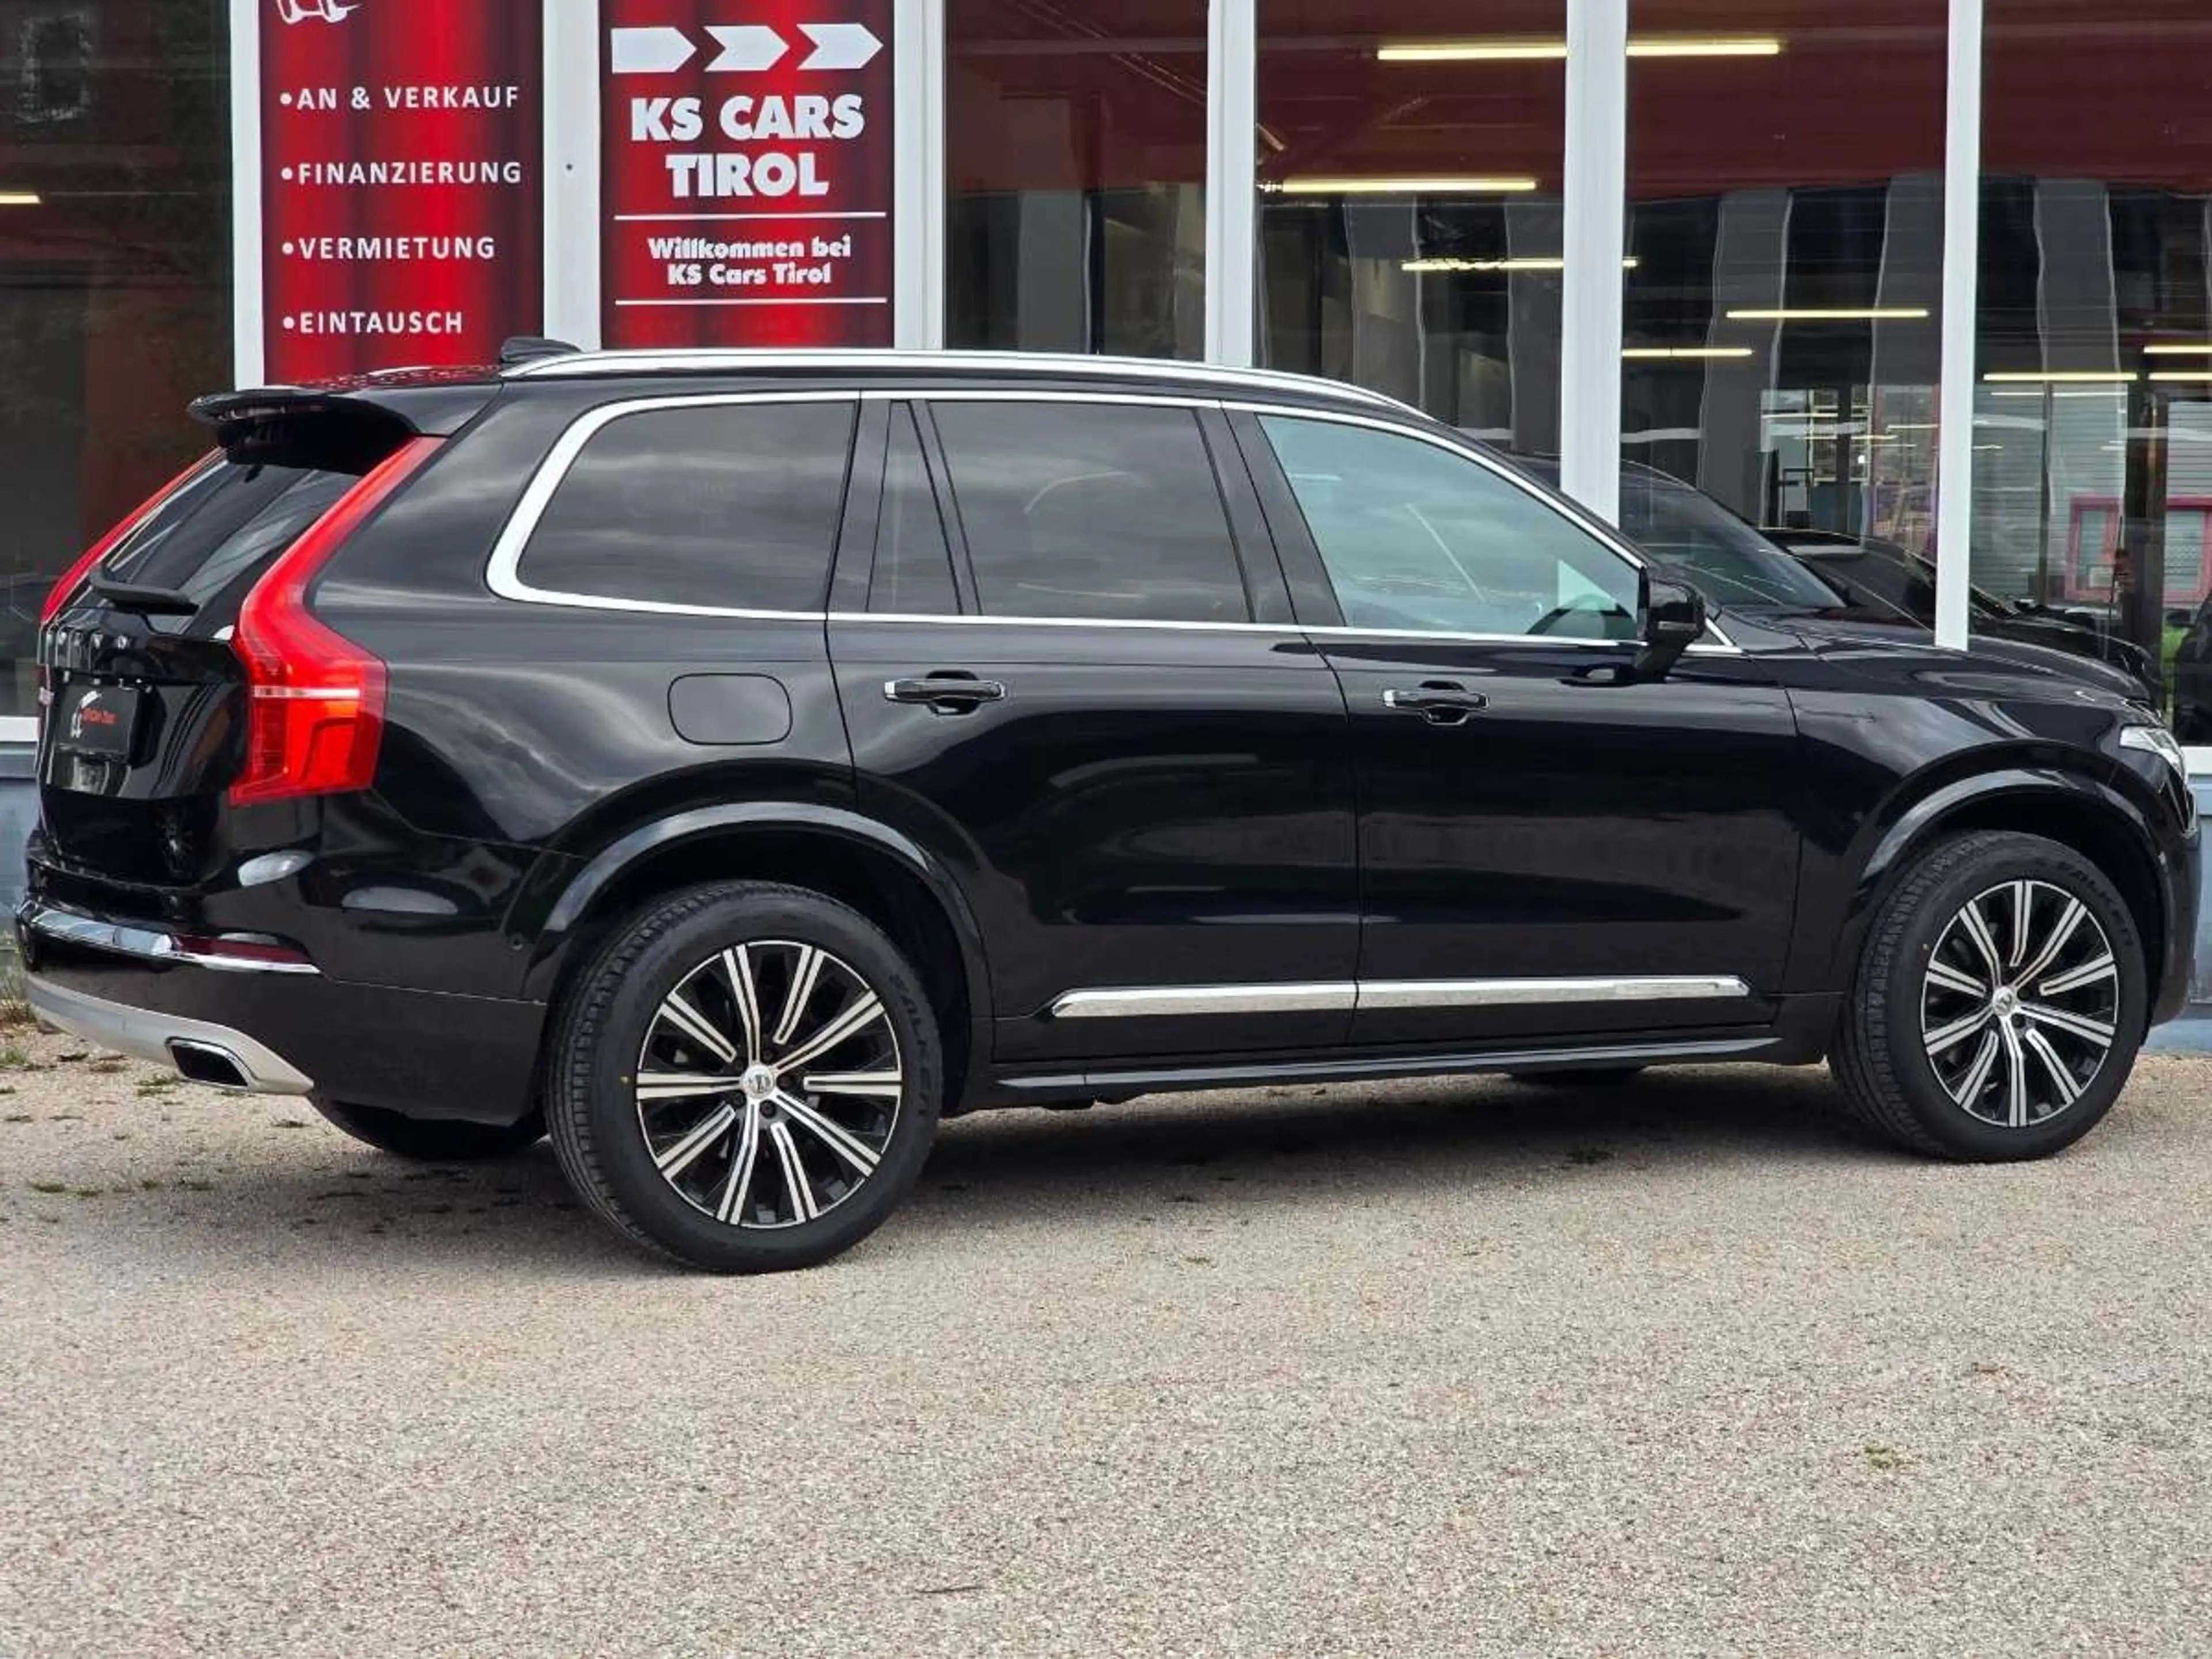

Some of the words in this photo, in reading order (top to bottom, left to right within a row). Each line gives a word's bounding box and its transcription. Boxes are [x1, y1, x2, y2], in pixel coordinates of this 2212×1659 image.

[297, 88, 336, 109] AN
[351, 86, 370, 109] &
[384, 86, 518, 108] VERKAUF
[631, 97, 703, 141] KS
[719, 94, 865, 141] CARS
[298, 162, 521, 184] FINANZIERUNG
[665, 152, 830, 198] TIROL
[298, 237, 495, 259] VERMIETUNG
[647, 237, 804, 259] Willkommen
[811, 234, 851, 257] bei
[668, 264, 702, 285] KS
[709, 264, 767, 285] Cars
[772, 262, 831, 284] Tirol
[300, 312, 462, 333] EINTAUSCH
